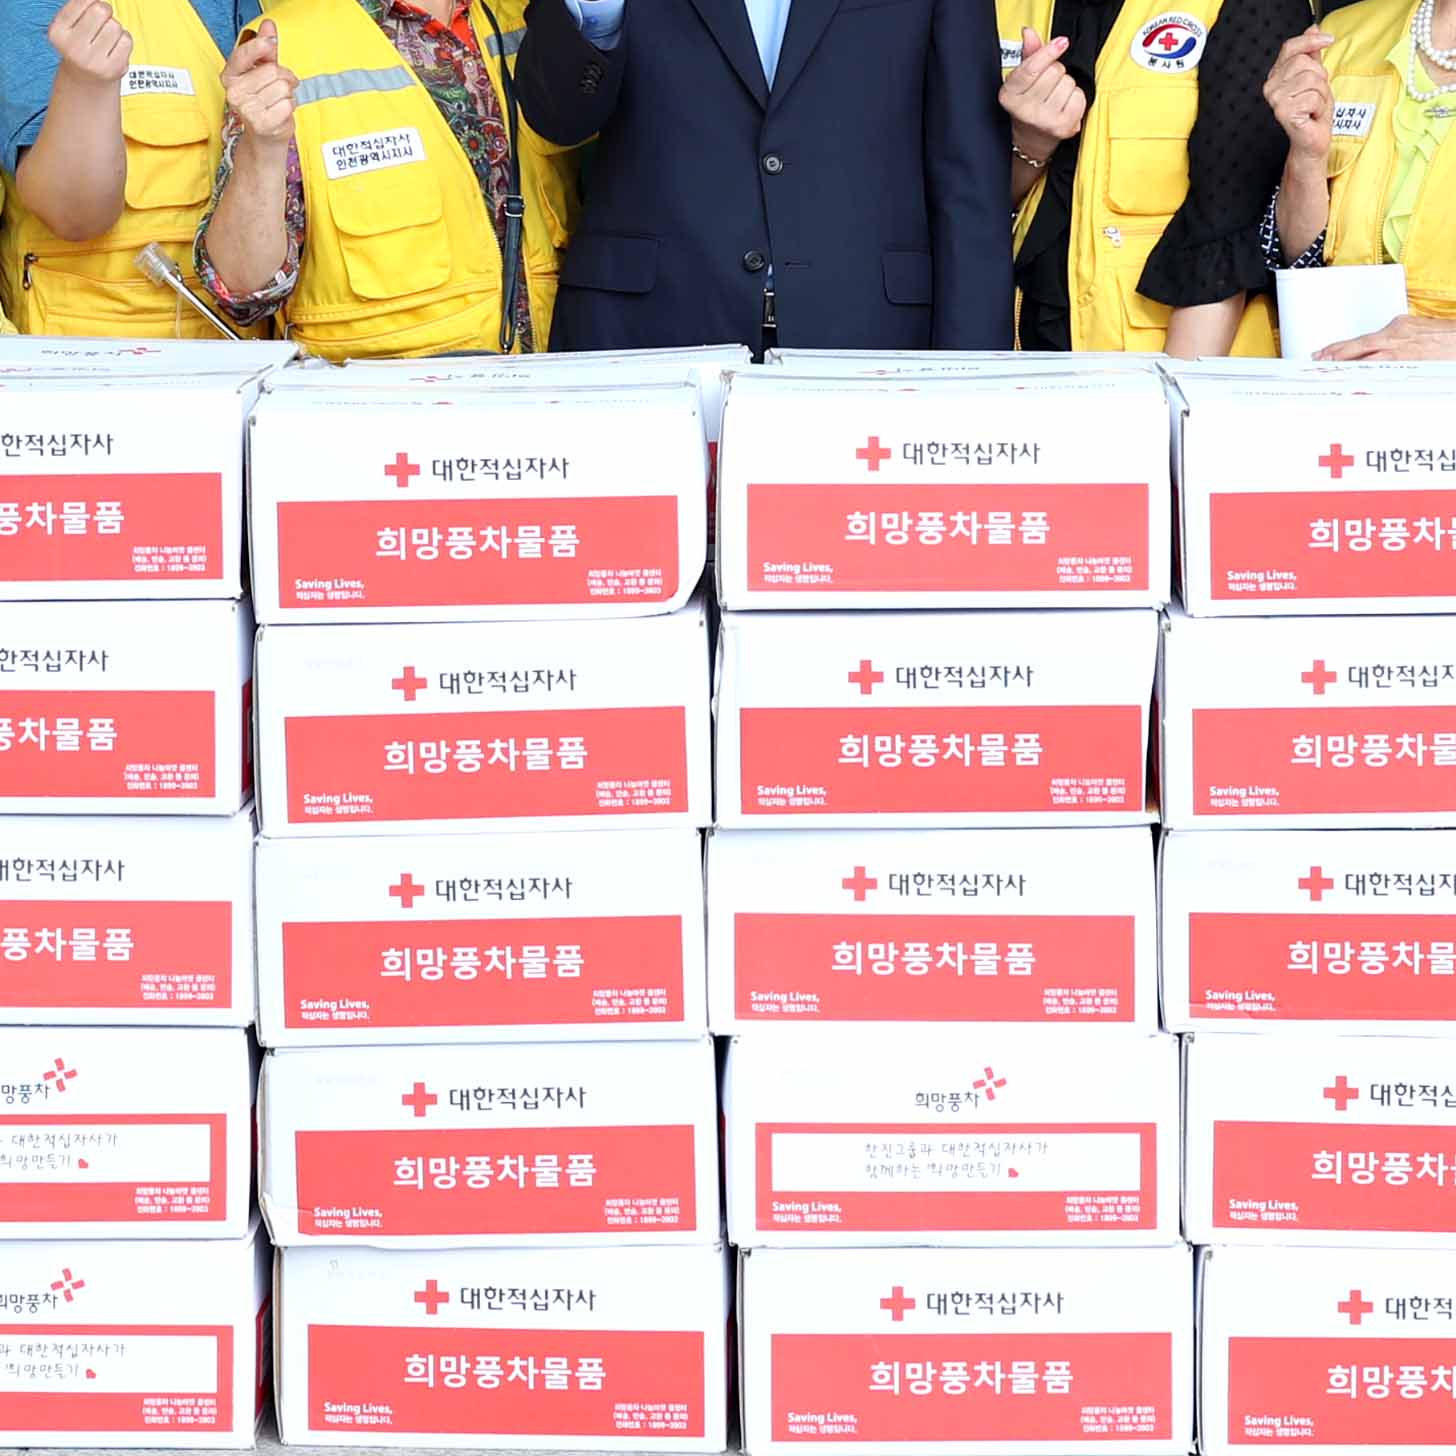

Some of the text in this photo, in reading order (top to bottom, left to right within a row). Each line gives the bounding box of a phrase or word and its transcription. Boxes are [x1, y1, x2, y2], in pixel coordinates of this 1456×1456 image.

[332, 133, 411, 158] 대한적십자사
[903, 441, 1040, 465] 대한적십자사
[432, 457, 569, 481] 대한적십자사
[844, 511, 1051, 545] 희망풍차물품
[375, 525, 580, 561] 희망풍차물품
[762, 562, 835, 575] Saving Lives,
[440, 669, 576, 694] 대한적십자사
[896, 665, 1034, 689] 대한적십자사
[383, 736, 588, 775] 희망풍차물품
[838, 733, 1043, 768] 희망풍차물품
[436, 877, 572, 902] 대한적십자사
[889, 872, 1026, 896] 대한적십자사
[380, 945, 585, 981] 희망풍차물품
[831, 941, 1036, 976] 희망풍차물품
[299, 999, 372, 1012] Saving Lives,
[449, 1087, 586, 1111] 대한적십자사
[915, 1092, 981, 1112] 희망풍차
[393, 1154, 597, 1190] 희망풍차물품
[460, 1286, 596, 1311] 대한적십자사
[927, 1291, 1064, 1315] 대한적십자사
[404, 1353, 606, 1390] 희망풍차물품
[869, 1361, 1074, 1395] 희망풍차물품
